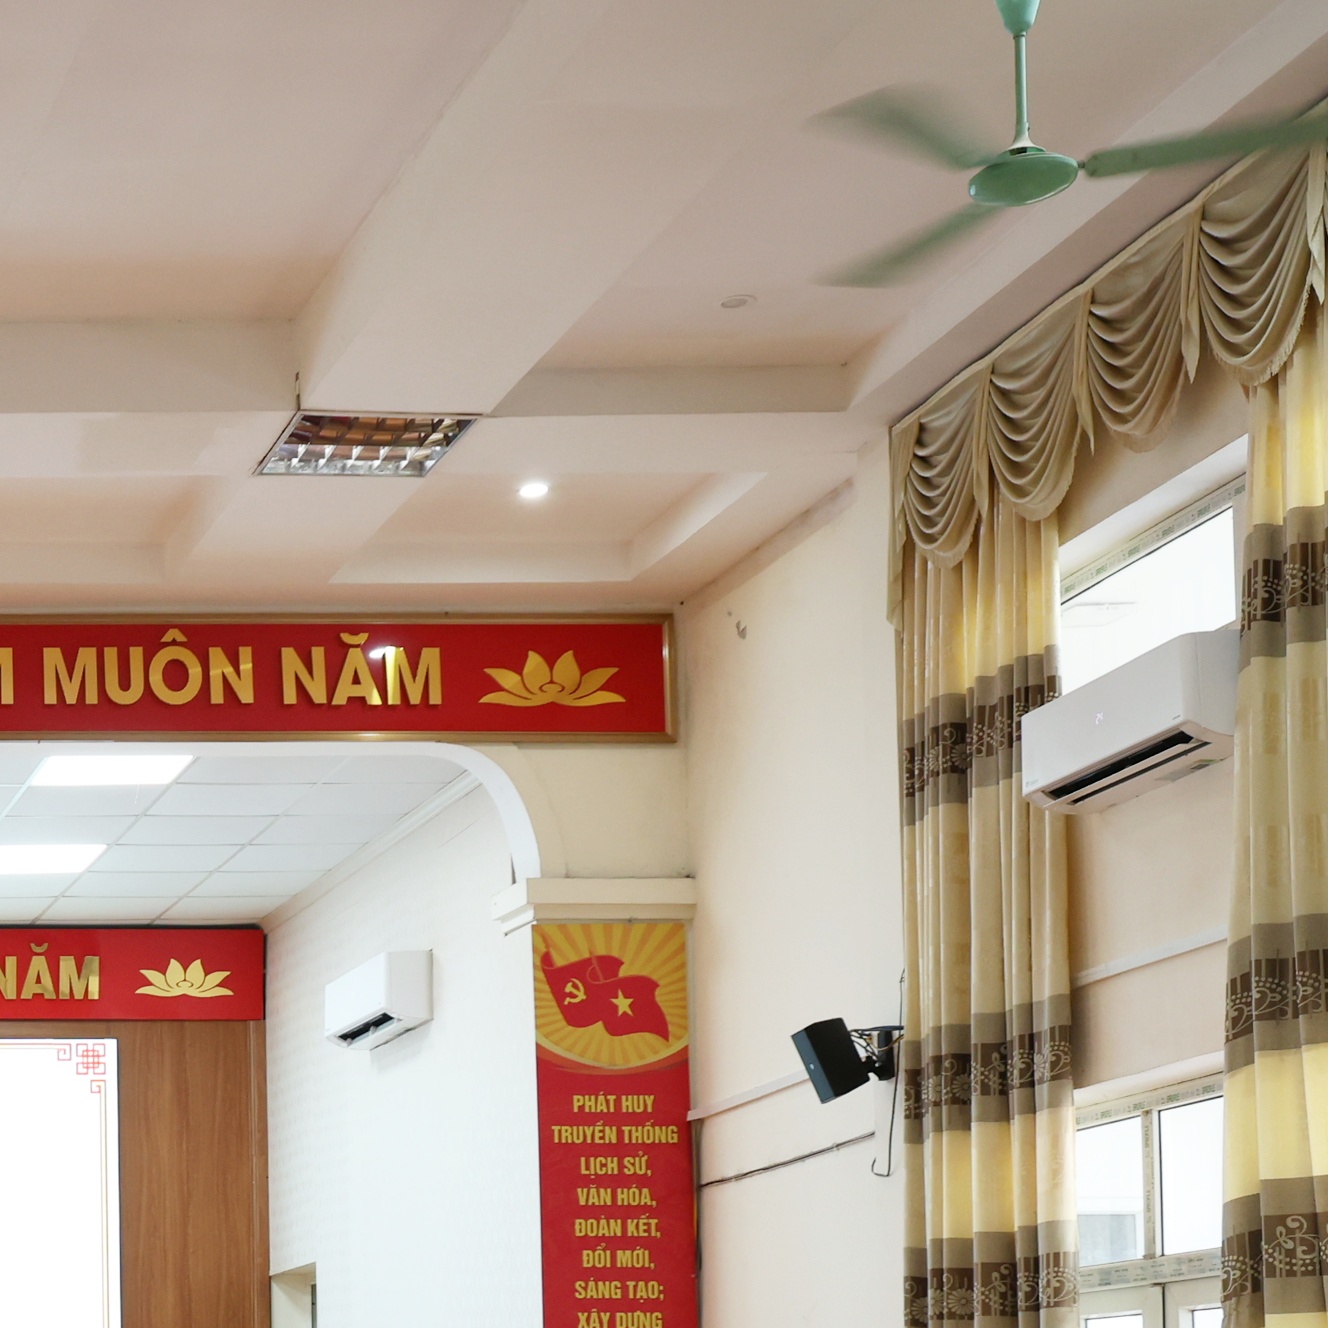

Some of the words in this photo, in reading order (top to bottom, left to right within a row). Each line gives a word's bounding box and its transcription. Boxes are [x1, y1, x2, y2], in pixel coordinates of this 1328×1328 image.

[44, 629, 254, 705] MUÔN
[282, 633, 441, 706] NĂM
[573, 1091, 616, 1112] PHÁT
[622, 1095, 654, 1112] HUY
[552, 1121, 617, 1143] TRUYỀN
[622, 1119, 677, 1143] THỐNG
[581, 1157, 618, 1178] LỊCH
[624, 1152, 651, 1176] SỬ,
[578, 1185, 611, 1205] VĂN
[618, 1185, 656, 1206] HÓA,
[575, 1216, 621, 1236] ĐOÀN
[628, 1213, 660, 1238] KẾT,
[583, 1243, 611, 1267] ĐỔI
[617, 1247, 654, 1268] MỚI,
[575, 1278, 621, 1298] SÁNG
[627, 1281, 663, 1302] TẠO;
[578, 1309, 610, 1328] XÂY
